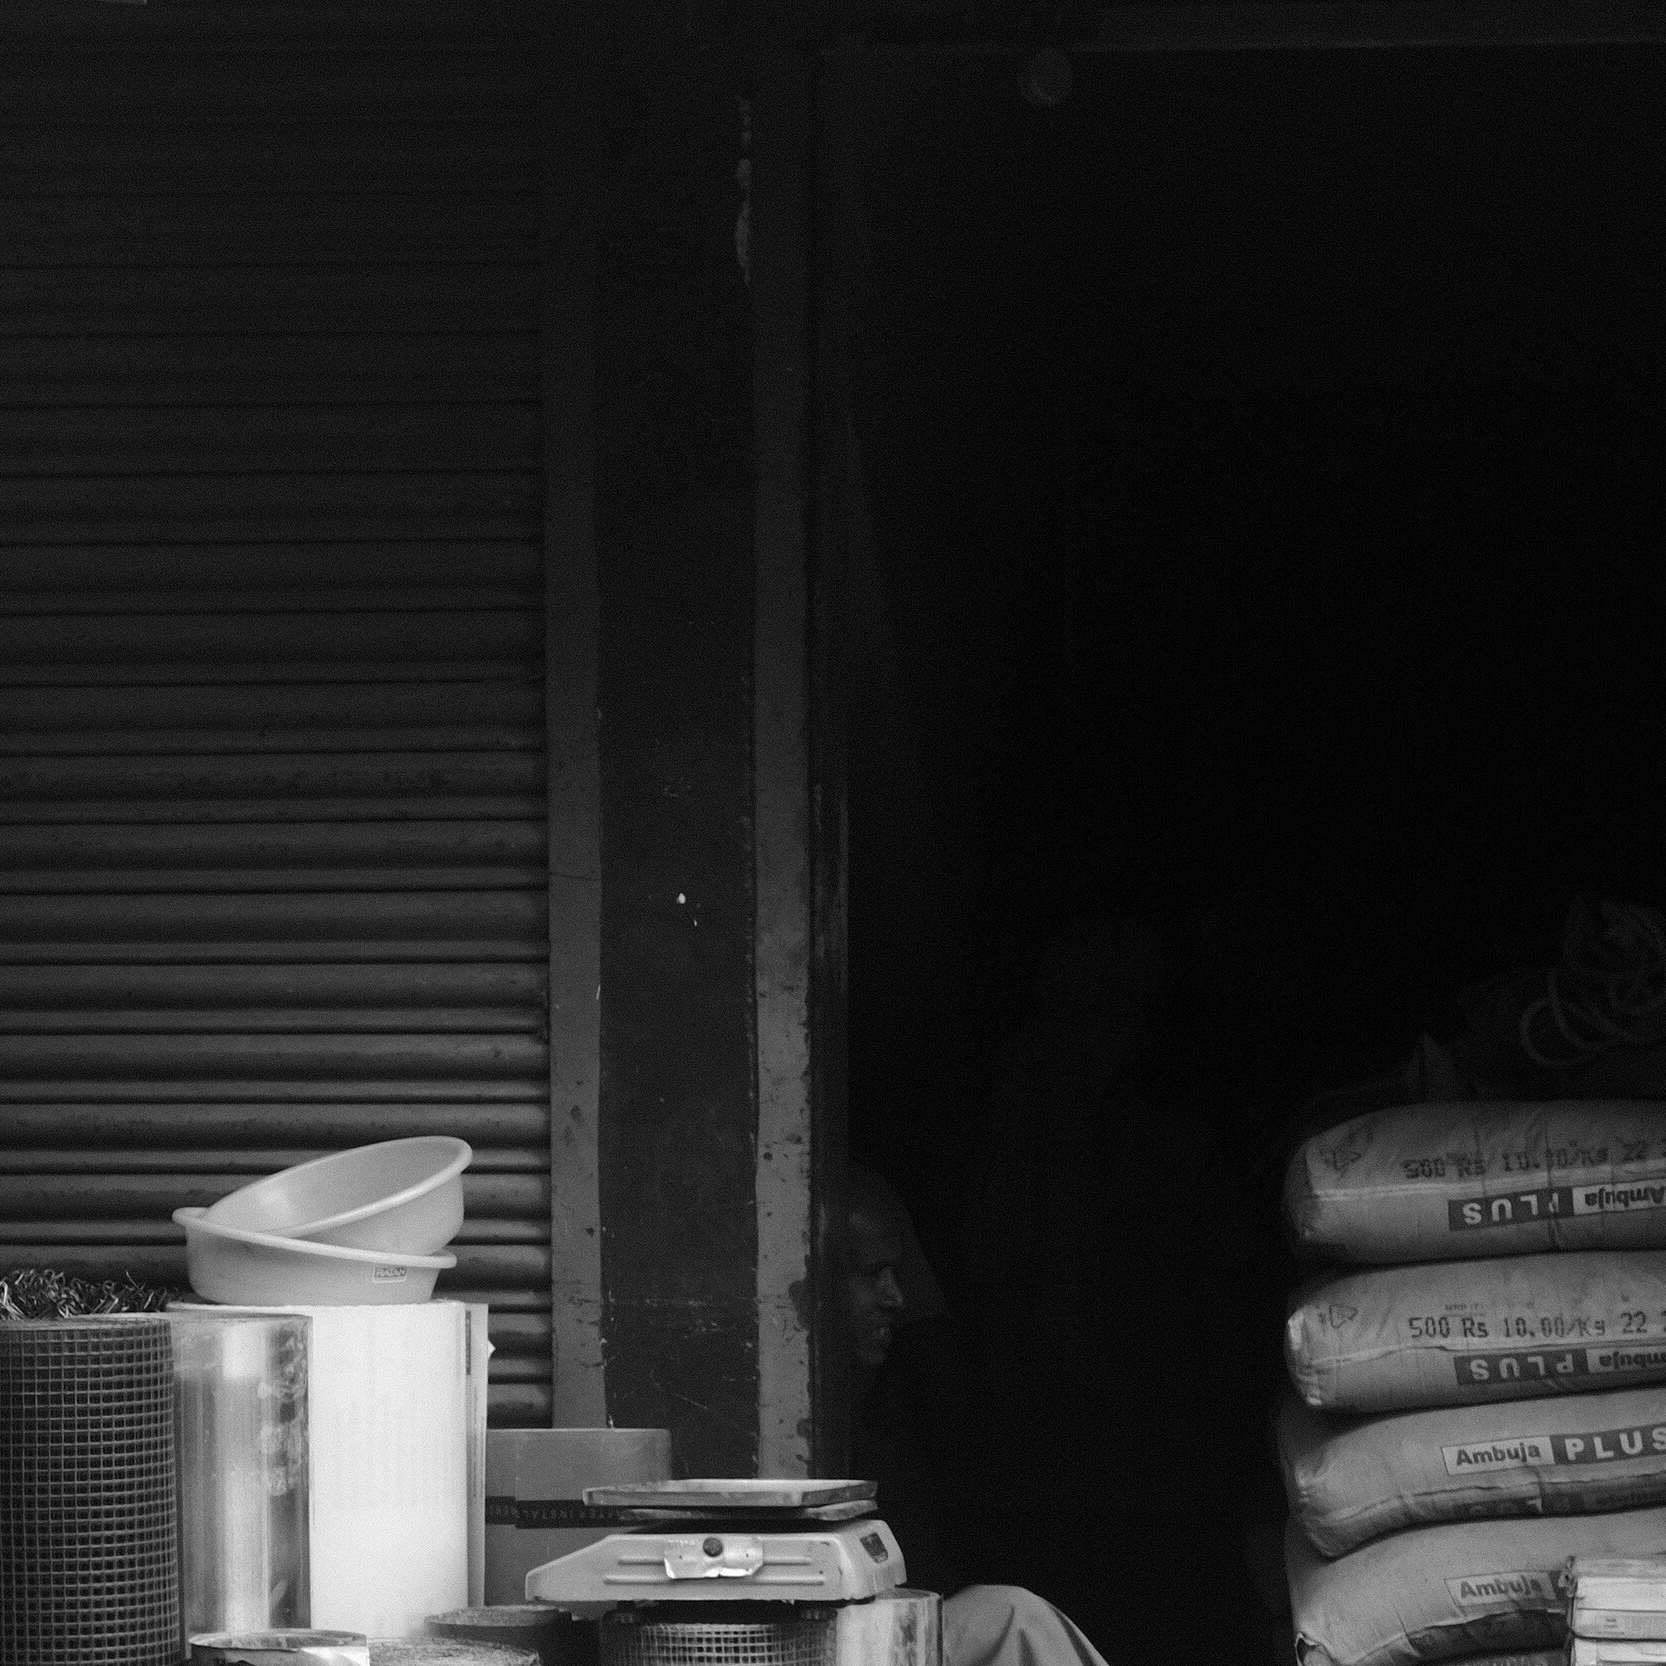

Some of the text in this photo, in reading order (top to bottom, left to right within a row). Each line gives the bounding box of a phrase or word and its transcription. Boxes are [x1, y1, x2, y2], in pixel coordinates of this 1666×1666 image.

[1585, 1185, 1666, 1208] Ambuja
[1408, 1317, 1450, 1339] 500
[1462, 1316, 1490, 1339] Rs
[1621, 1311, 1648, 1335] 22
[1469, 1353, 1575, 1381] PLUS
[1456, 1442, 1541, 1467] Ambuja
[1460, 1574, 1542, 1600] Ambuja
